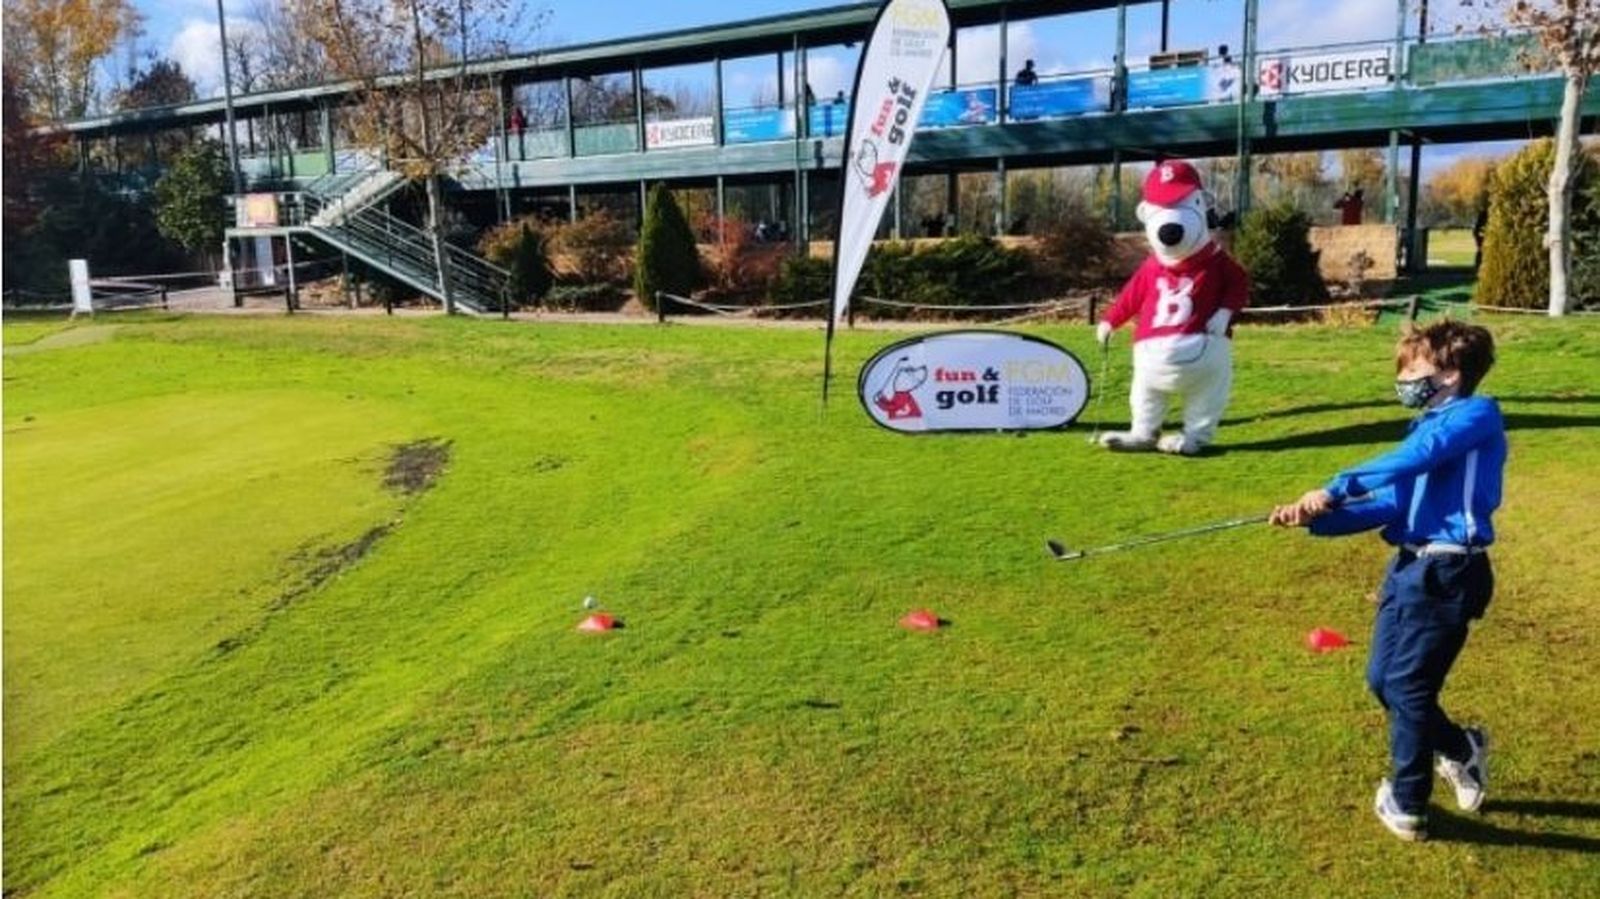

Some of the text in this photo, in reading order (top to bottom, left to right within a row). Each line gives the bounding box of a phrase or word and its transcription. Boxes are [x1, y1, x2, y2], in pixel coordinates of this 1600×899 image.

[871, 99, 894, 137] fun
[888, 82, 917, 146] golf
[1160, 165, 1175, 183] B
[1154, 276, 1194, 328] B
[935, 366, 999, 382] fun &
[936, 384, 999, 410] golf
